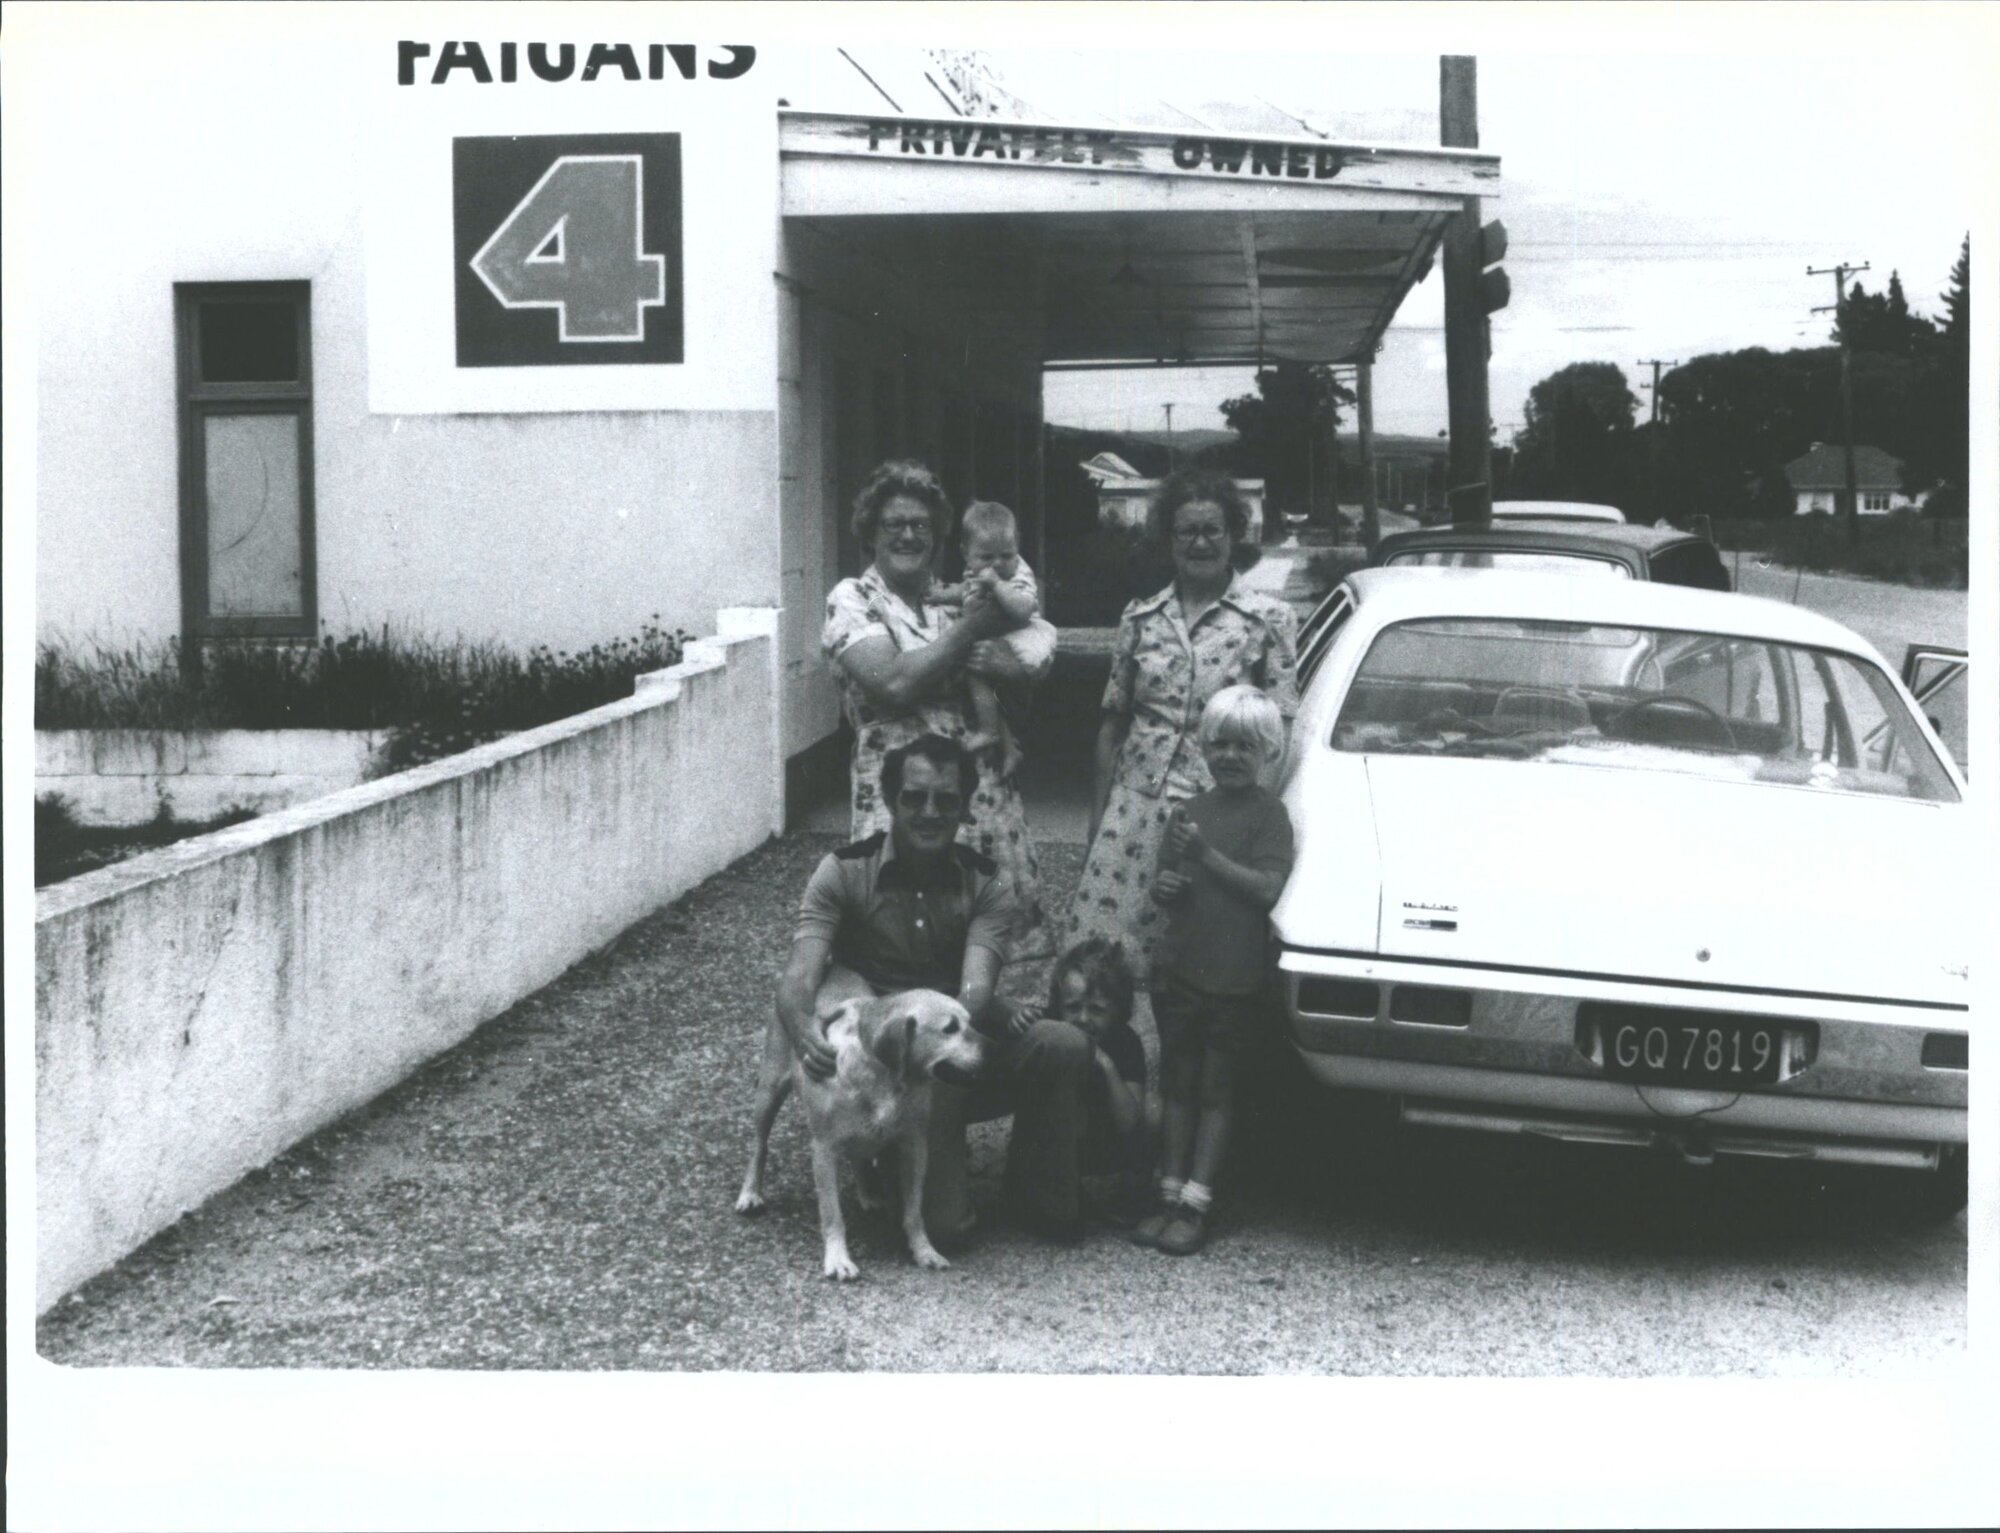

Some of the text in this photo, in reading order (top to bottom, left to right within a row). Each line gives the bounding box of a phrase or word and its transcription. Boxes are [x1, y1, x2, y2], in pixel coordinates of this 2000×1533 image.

[1173, 138, 1343, 179] OWNED
[469, 154, 665, 342] 4
[1616, 1025, 1771, 1073] GQ 7819
